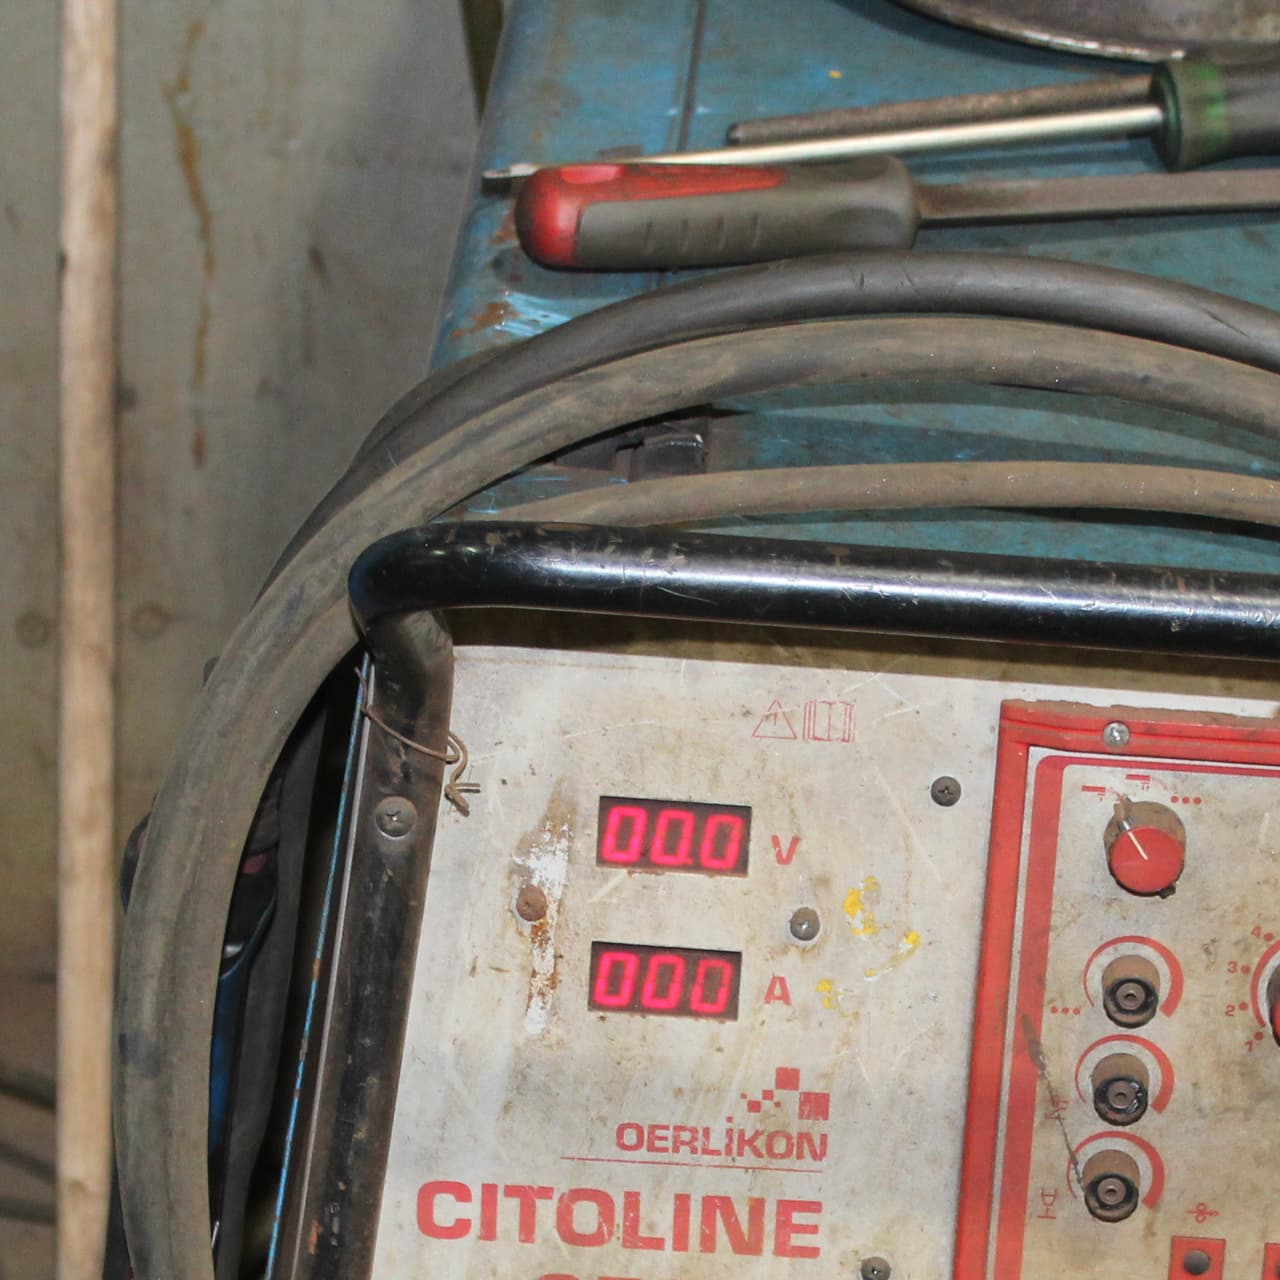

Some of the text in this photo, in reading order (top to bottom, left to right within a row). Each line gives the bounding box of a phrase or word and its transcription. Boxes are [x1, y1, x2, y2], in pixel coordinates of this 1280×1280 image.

[771, 834, 800, 865] V
[1251, 926, 1262, 939] 4
[1227, 961, 1238, 973] 3
[593, 951, 733, 1014] 000
[764, 975, 792, 1006] A
[1225, 1005, 1236, 1017] 2
[1245, 1041, 1254, 1052] 1
[416, 1180, 822, 1259] CITOLINE
